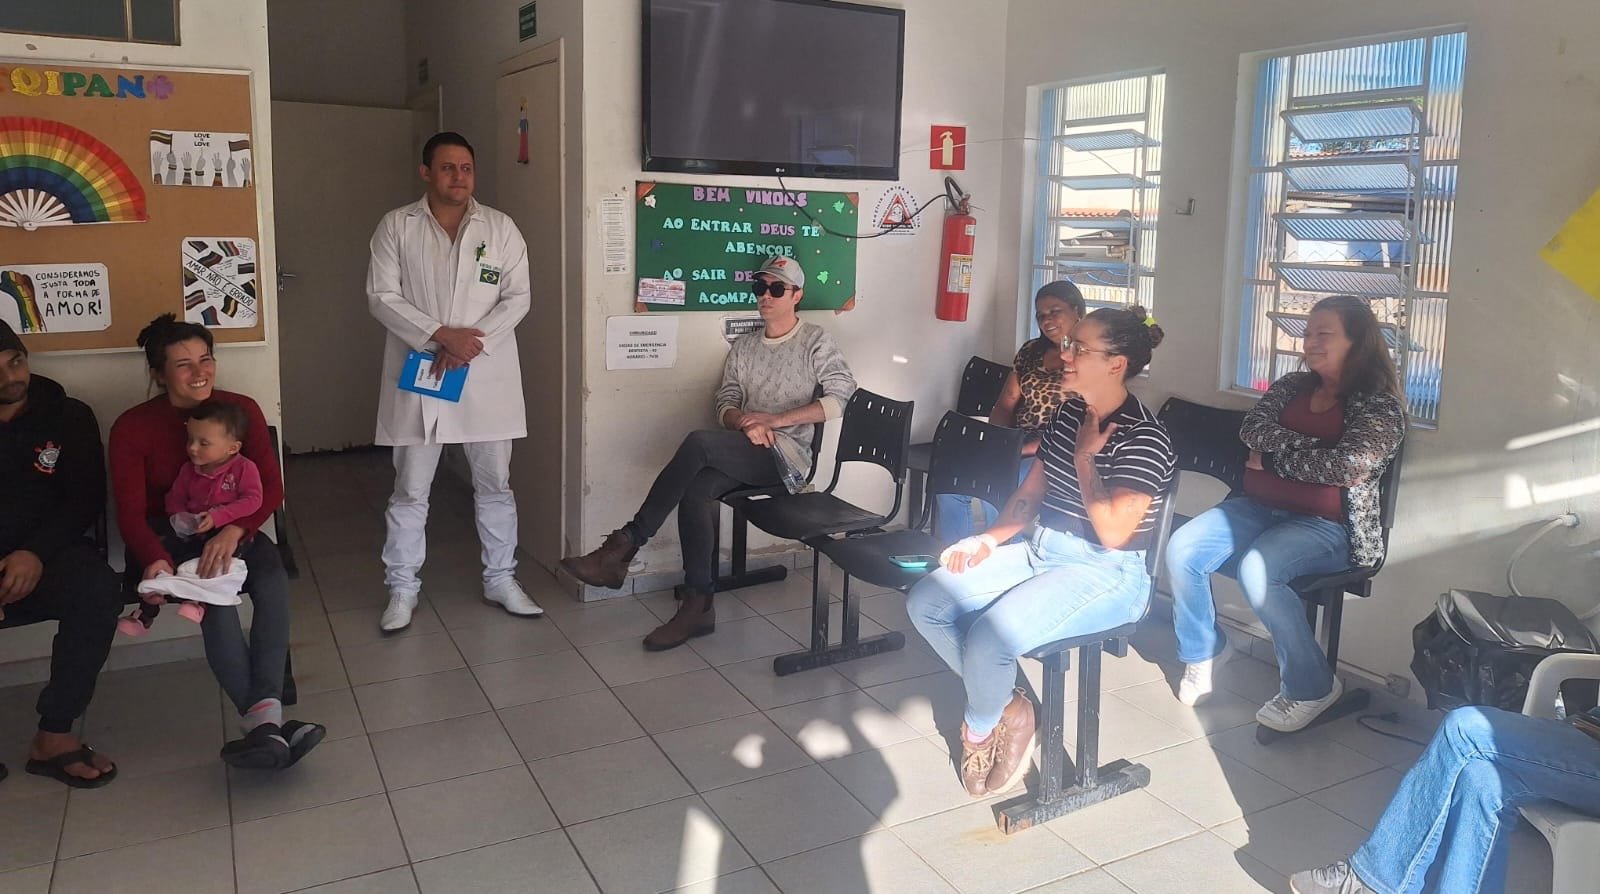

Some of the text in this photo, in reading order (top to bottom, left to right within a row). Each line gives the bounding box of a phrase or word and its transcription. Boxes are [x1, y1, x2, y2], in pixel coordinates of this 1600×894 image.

[693, 186, 730, 202] BEM
[663, 217, 820, 237] AO ENTRAR DEUS TE
[35, 270, 100, 281] CONSIDERAMOS
[663, 268, 758, 282] AO SAIR DE
[40, 279, 96, 289] JUSTA TODA
[186, 260, 207, 276] AMAR
[229, 287, 254, 307] ERRADO
[43, 288, 100, 299] A FORMA DE
[699, 291, 758, 304] ACOMPA
[45, 299, 102, 317] AMOR!
